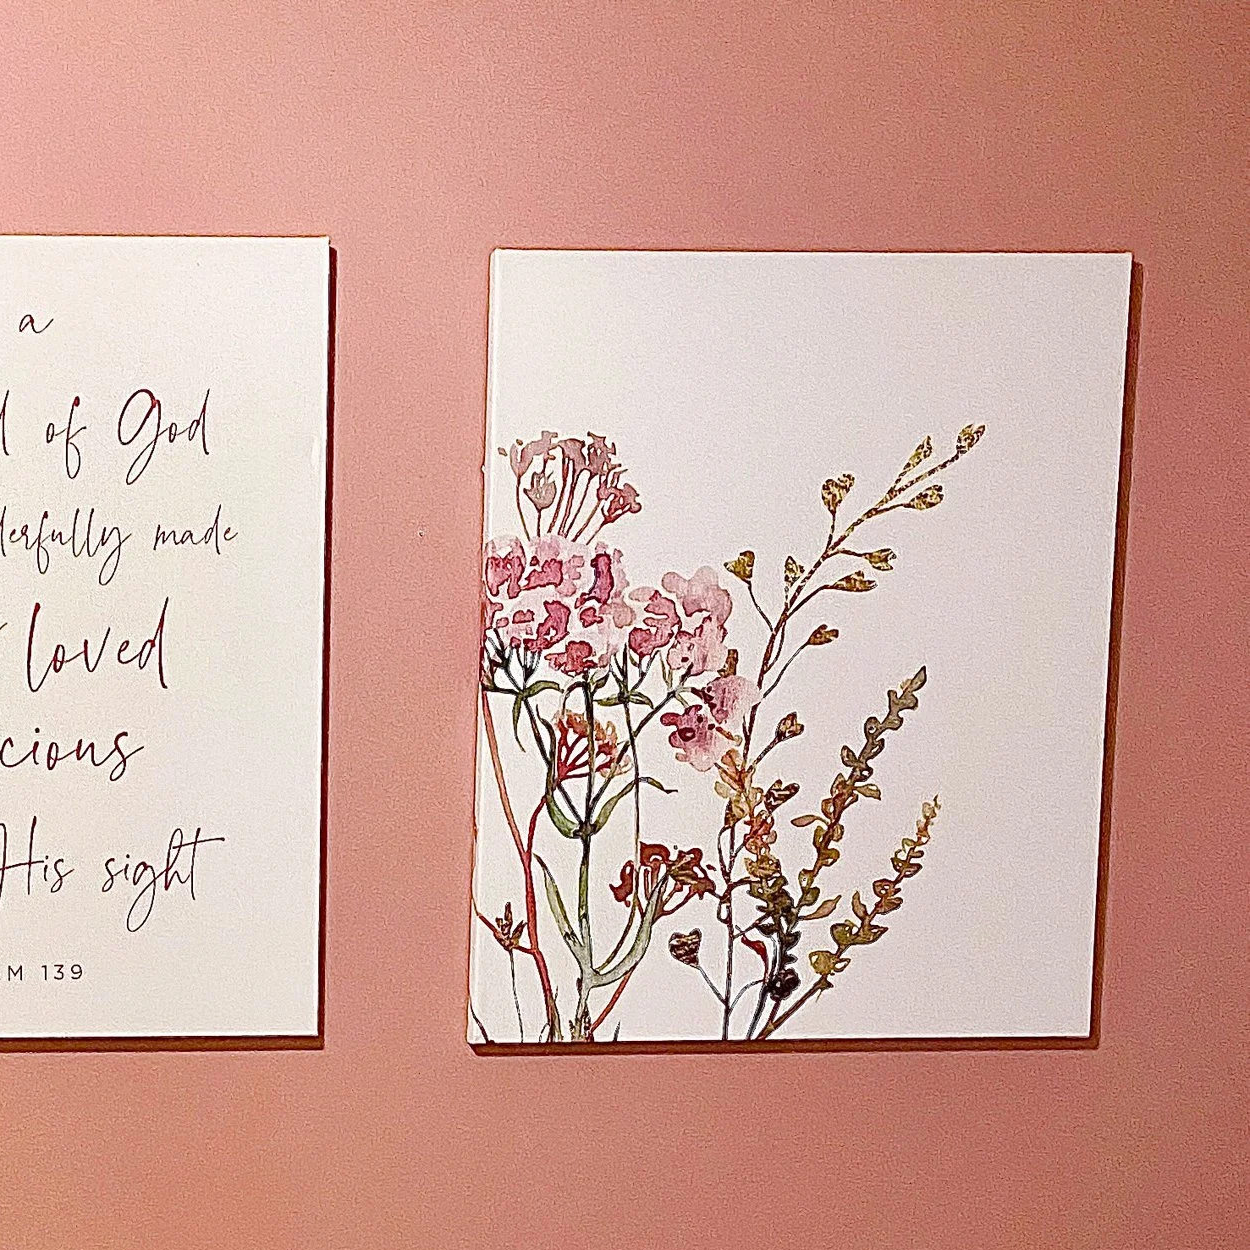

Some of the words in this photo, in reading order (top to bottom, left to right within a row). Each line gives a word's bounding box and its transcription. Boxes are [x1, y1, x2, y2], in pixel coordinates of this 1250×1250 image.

[19, 314, 53, 333] a
[46, 396, 87, 479] of
[118, 389, 210, 485] God
[153, 505, 237, 555] made
[27, 597, 169, 692] loved
[102, 828, 225, 932] sight
[41, 964, 84, 981] 139
